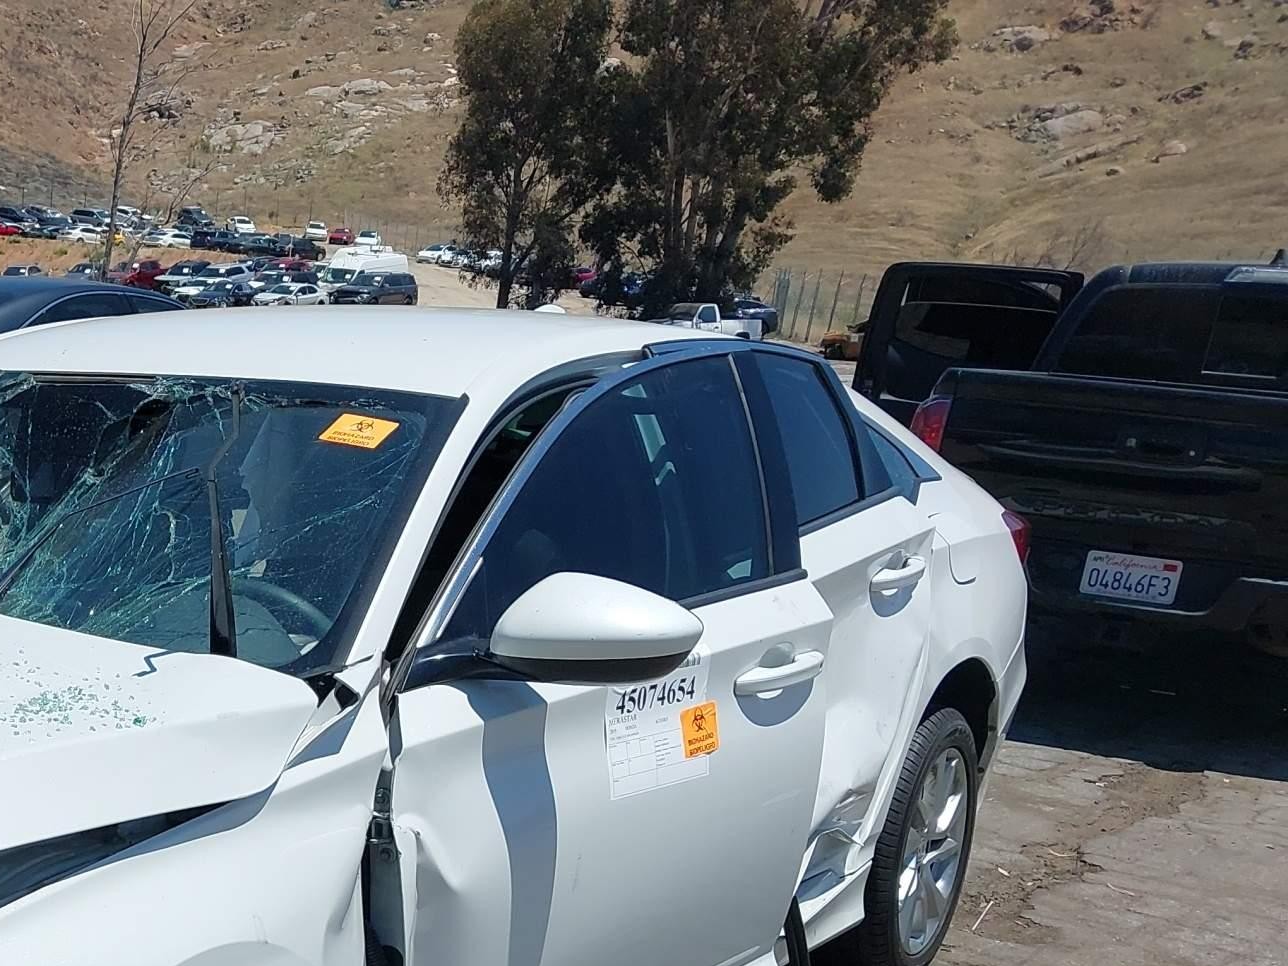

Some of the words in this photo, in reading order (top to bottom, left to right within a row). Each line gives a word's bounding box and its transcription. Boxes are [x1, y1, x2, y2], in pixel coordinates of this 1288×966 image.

[332, 431, 375, 441] BIOHAZARD
[1087, 568, 1172, 597] 04846F3
[616, 676, 696, 715] 45074654
[688, 732, 714, 746] BIOHAZARD
